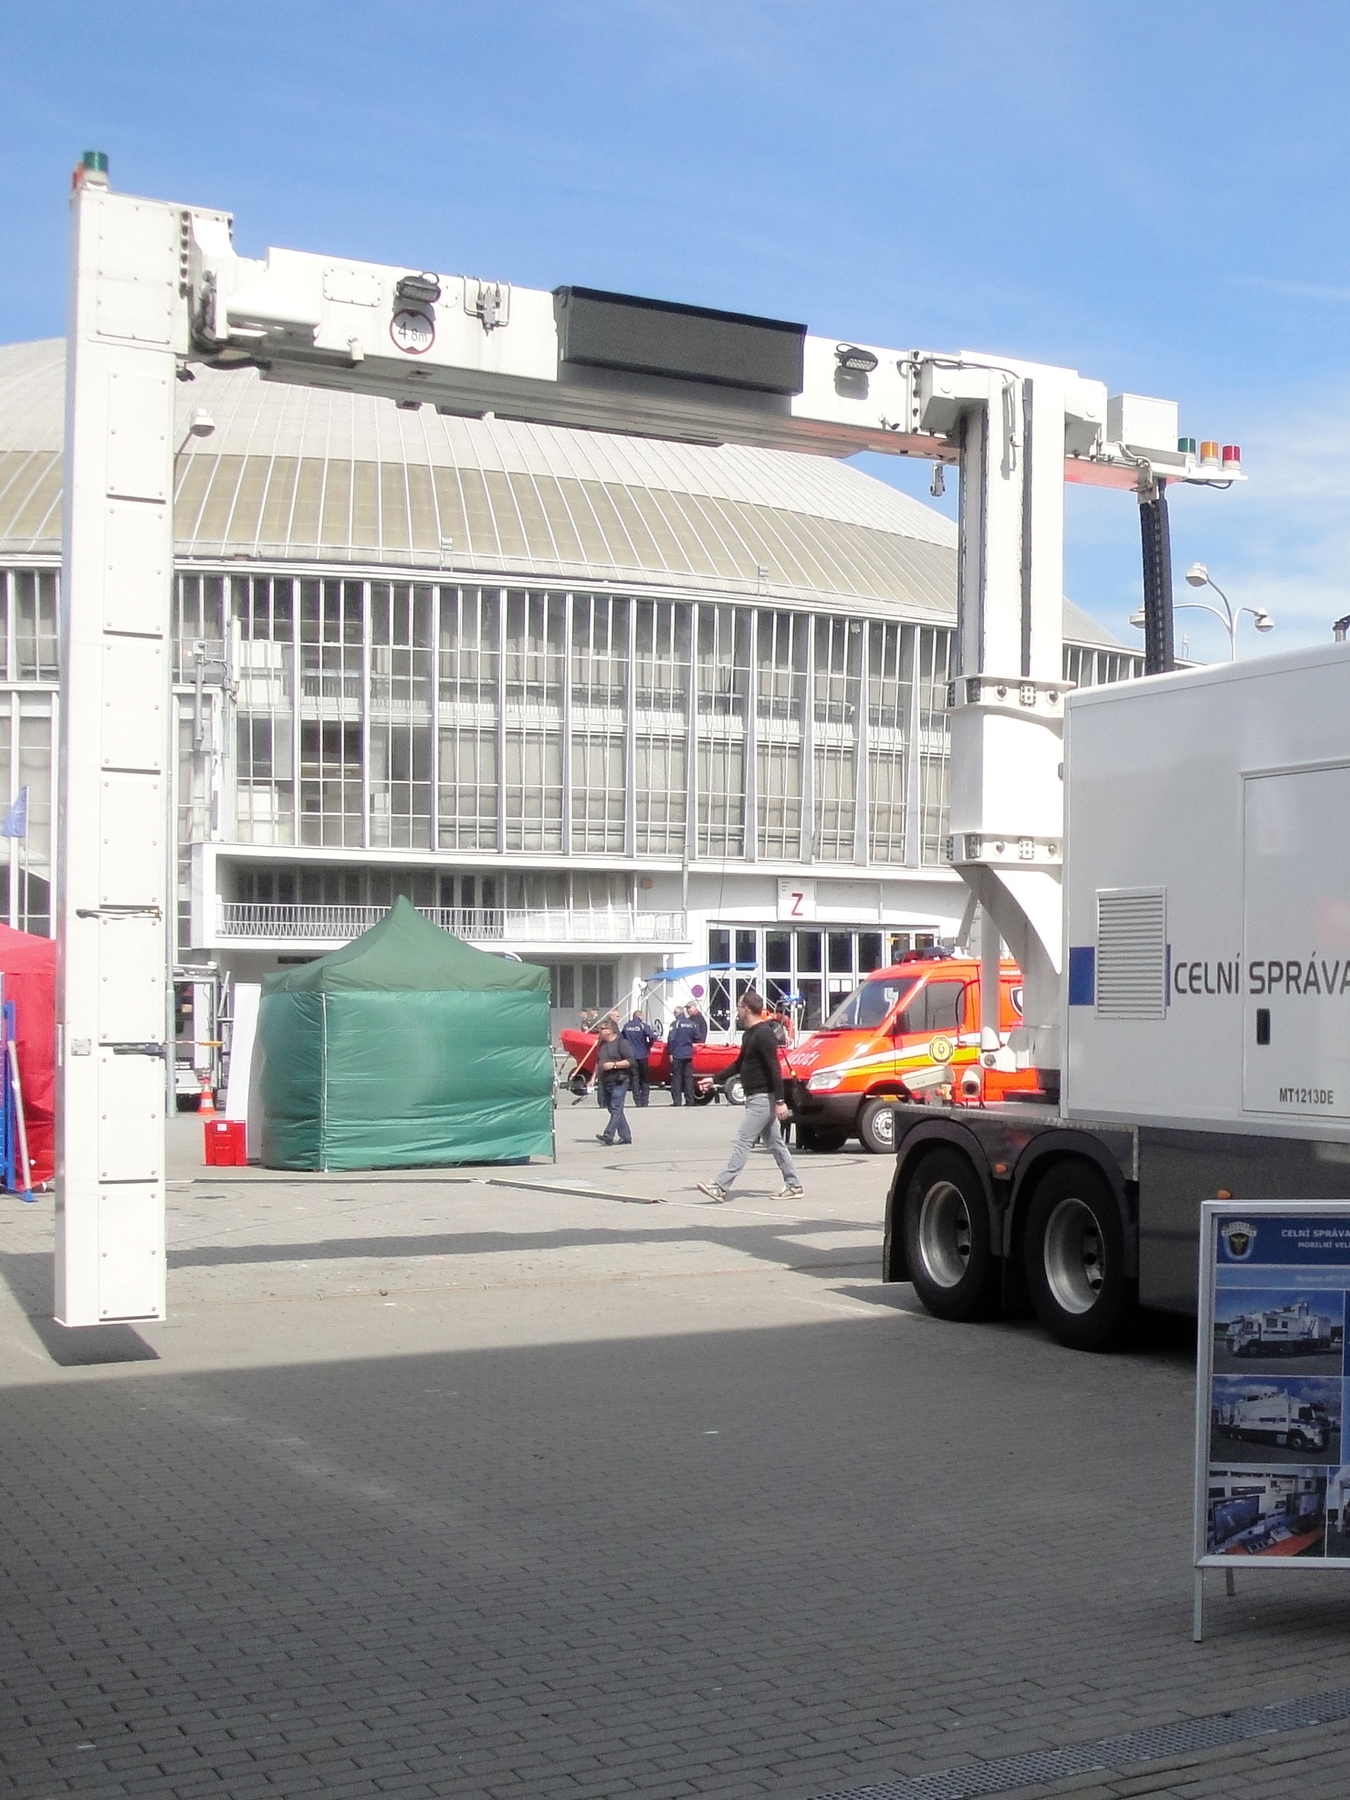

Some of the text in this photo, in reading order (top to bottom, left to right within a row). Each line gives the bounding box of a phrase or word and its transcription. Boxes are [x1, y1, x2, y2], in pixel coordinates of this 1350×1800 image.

[791, 892, 804, 916] Z
[1174, 952, 1240, 994] CELNÍ
[1279, 1087, 1334, 1104] MT1213DE
[1281, 1228, 1309, 1237] CELNÍ
[1313, 1228, 1350, 1238] SPRÁVA
